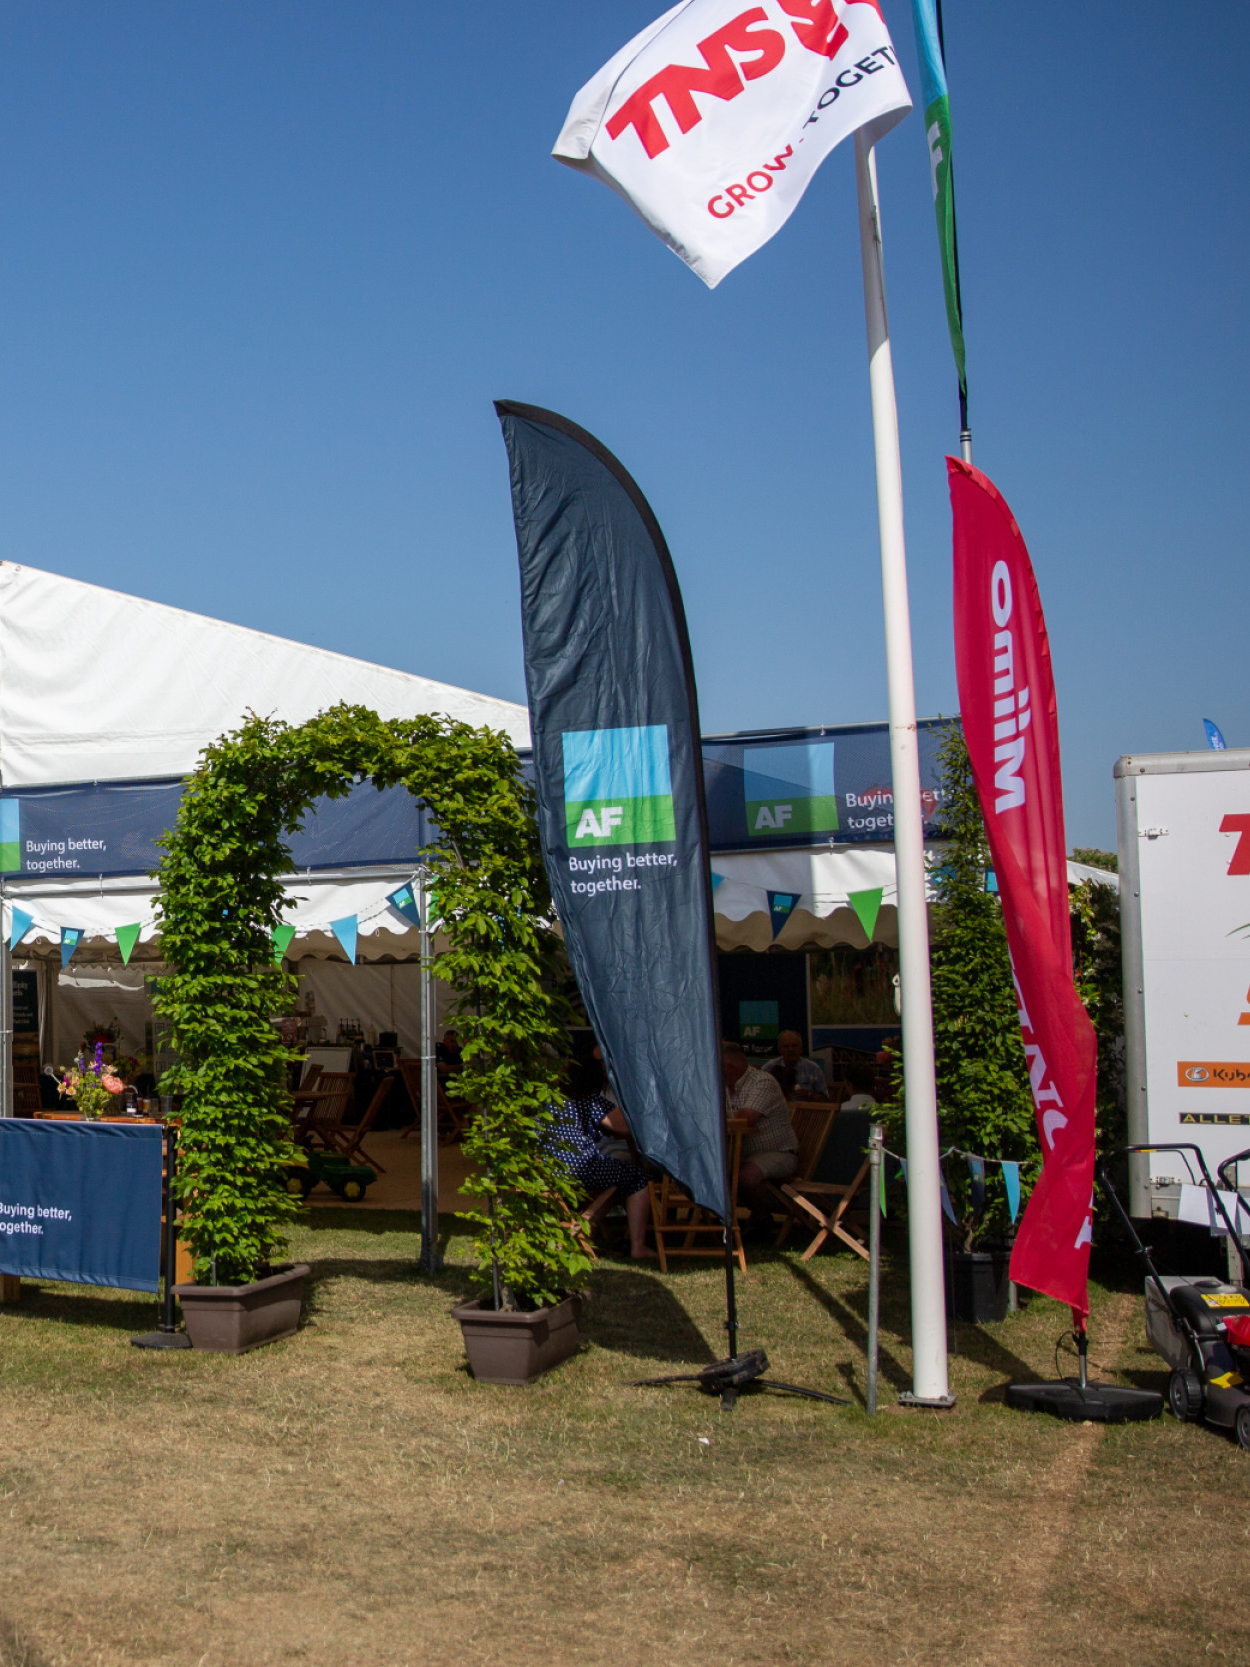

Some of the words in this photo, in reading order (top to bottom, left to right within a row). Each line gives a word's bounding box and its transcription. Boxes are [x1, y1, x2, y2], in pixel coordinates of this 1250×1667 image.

[707, 139, 802, 219] GROW
[803, 45, 896, 129] TOGET
[845, 790, 894, 811] Buyin
[575, 806, 623, 839] AF
[754, 804, 793, 830] AF
[26, 840, 66, 855] Buying
[67, 837, 107, 851] better,
[26, 856, 80, 873] together.
[569, 855, 622, 874] Buying
[626, 852, 678, 868] better,
[570, 875, 642, 897] together.
[743, 1026, 761, 1037] AF
[37, 1204, 72, 1221] better,
